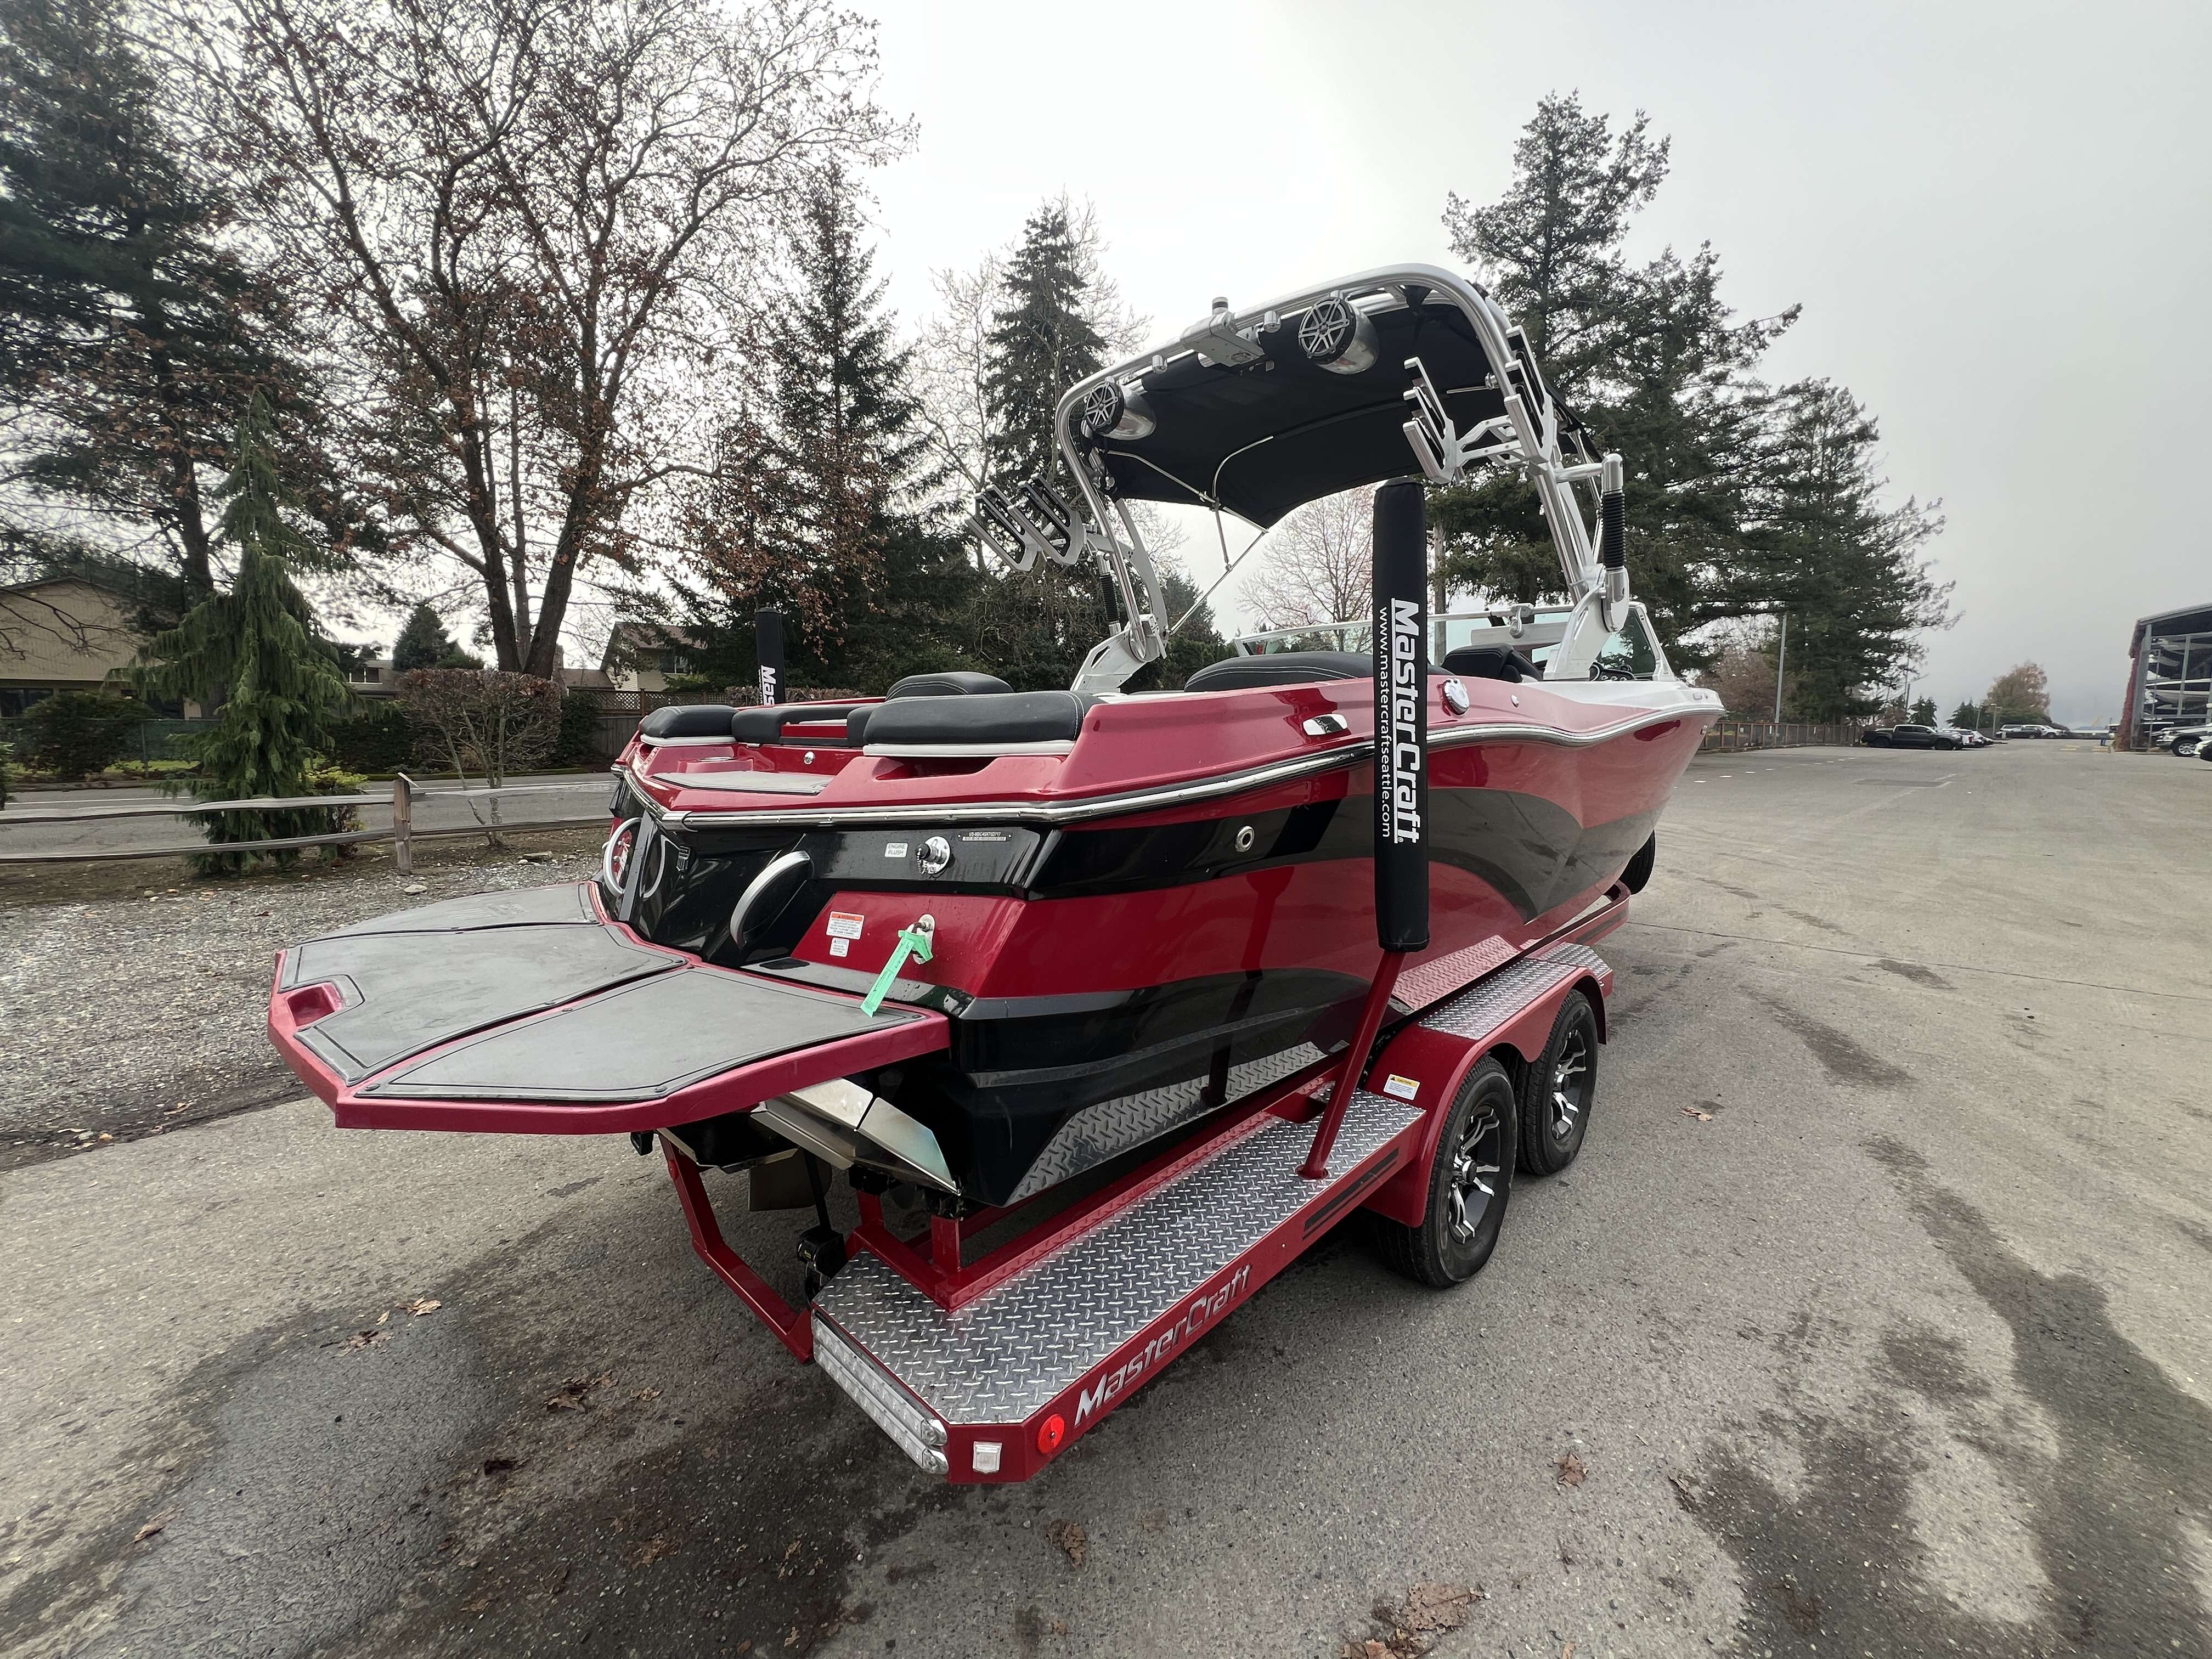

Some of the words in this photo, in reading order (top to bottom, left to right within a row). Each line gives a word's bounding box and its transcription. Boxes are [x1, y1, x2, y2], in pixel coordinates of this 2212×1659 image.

[1380, 606, 1392, 837] www.mastercraftseattle.com
[1395, 600, 1420, 843] MasterCraft
[1074, 1263, 1252, 1427] MasterCraft
